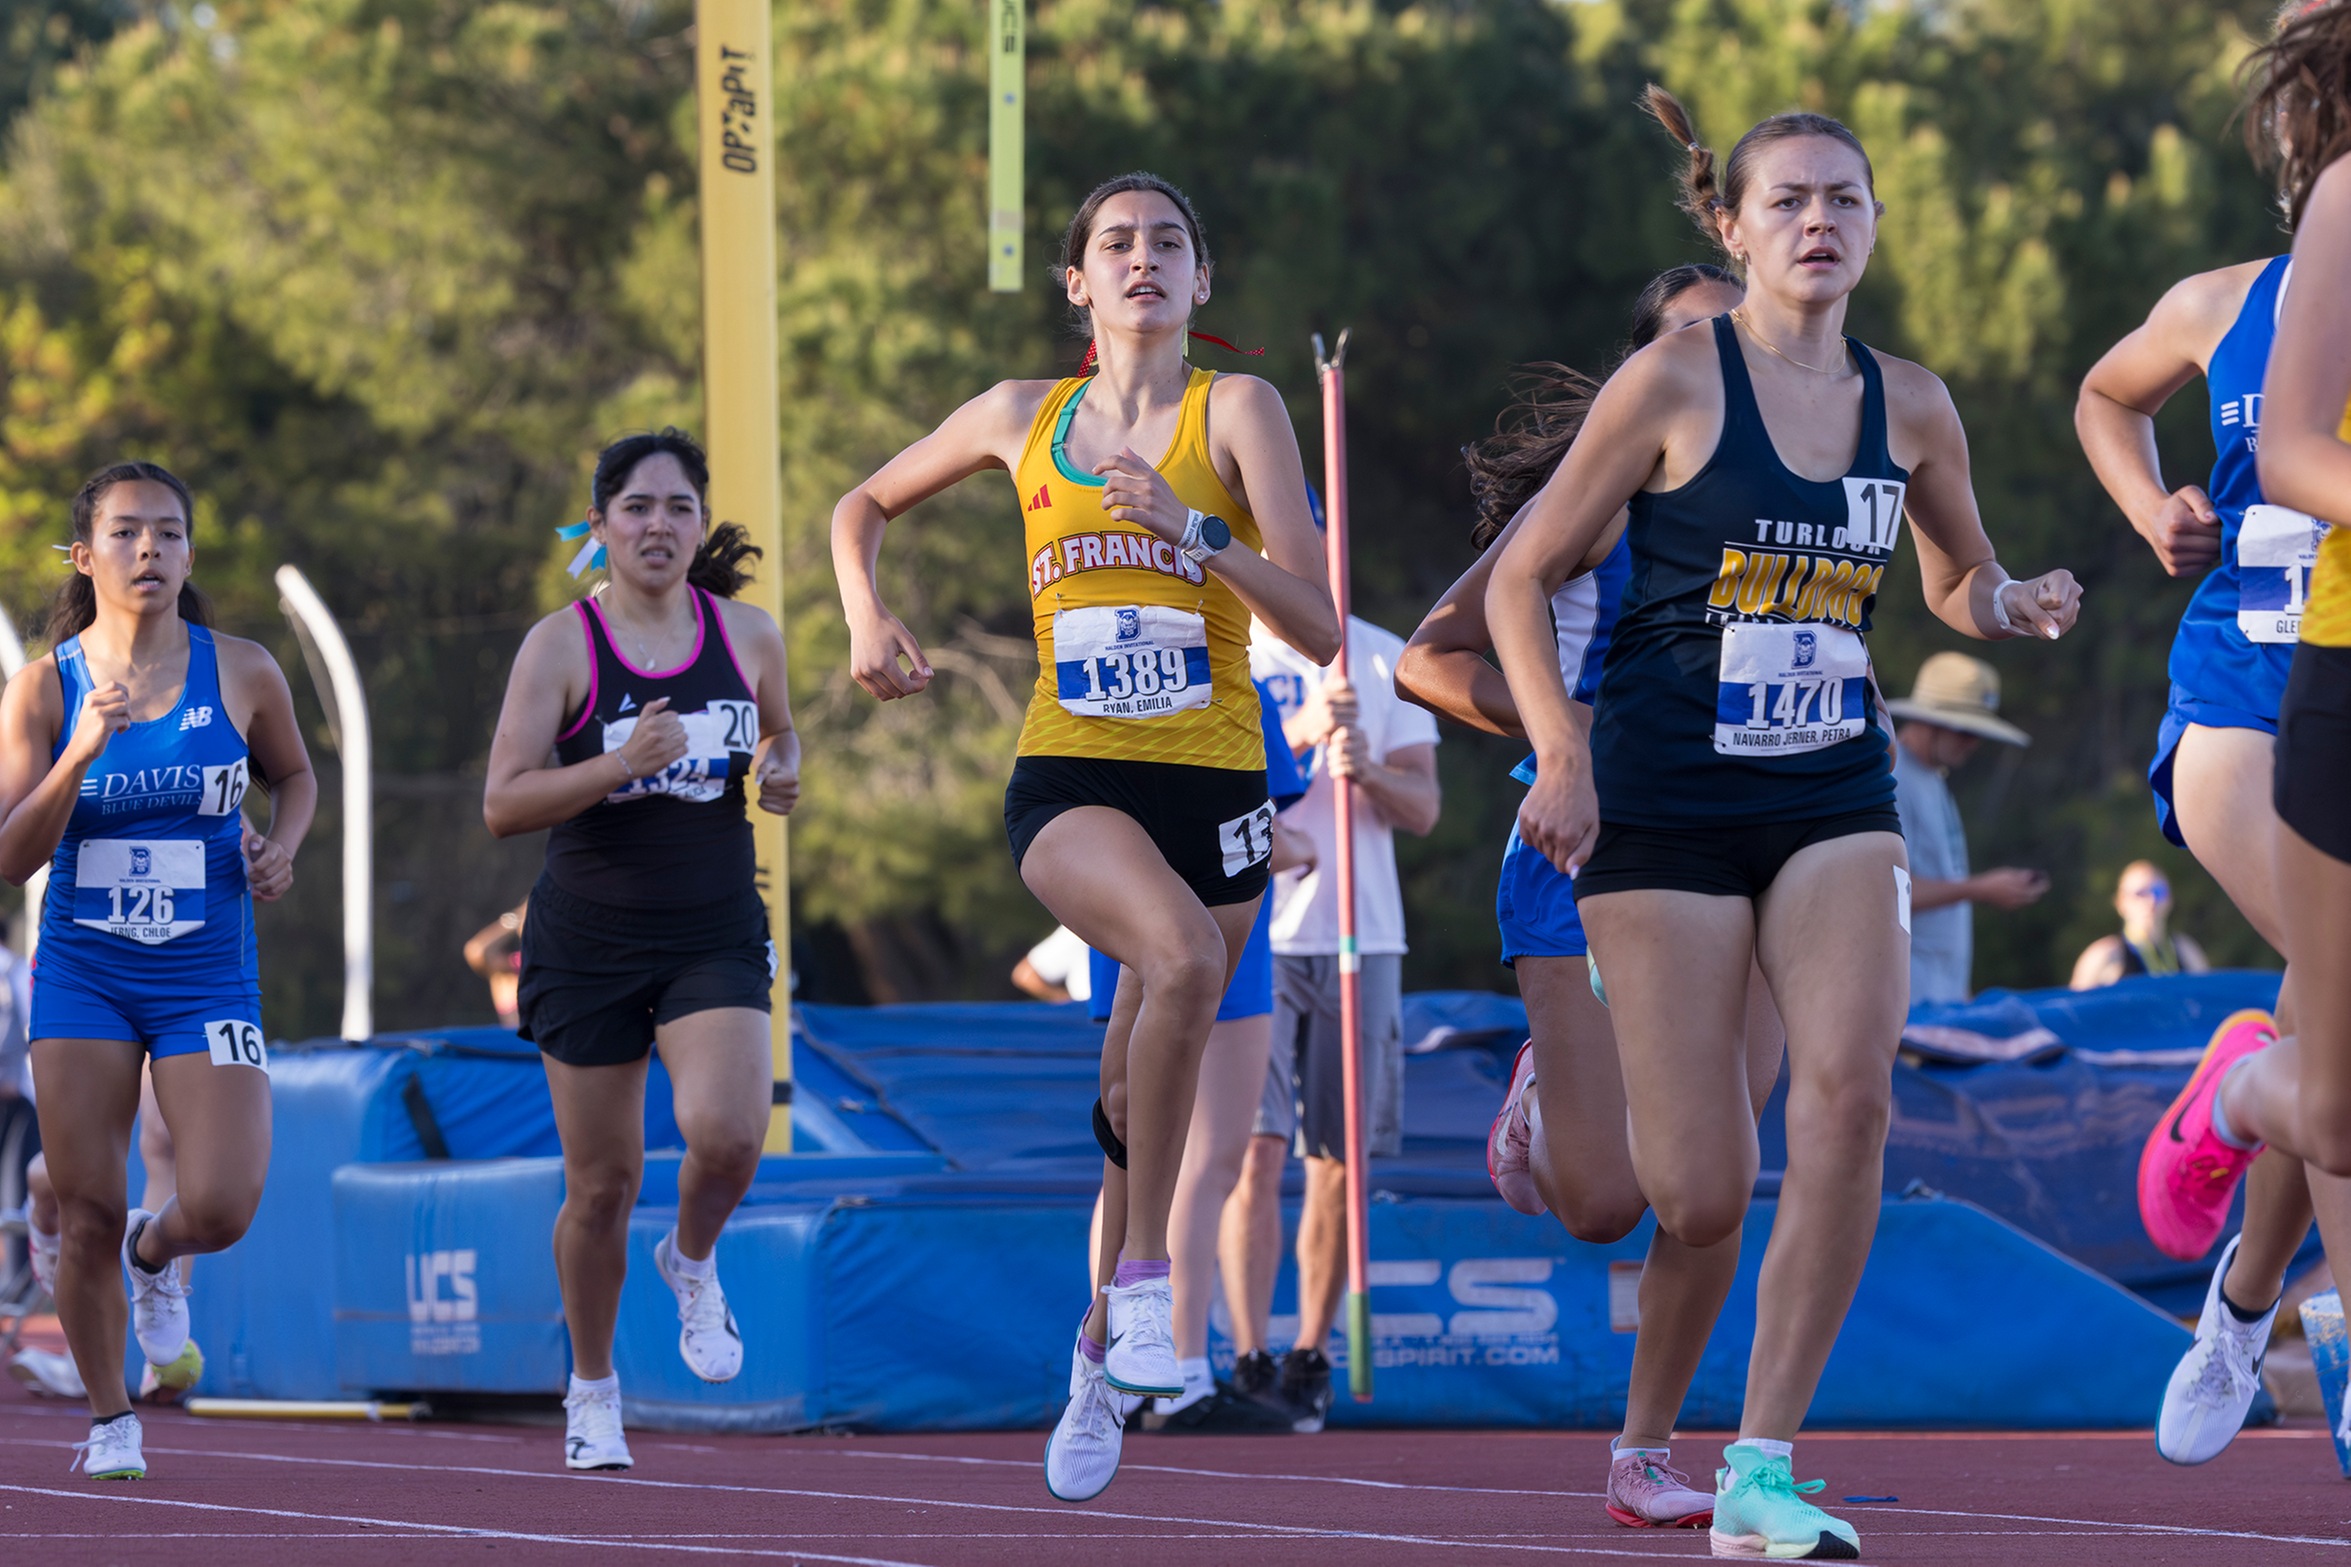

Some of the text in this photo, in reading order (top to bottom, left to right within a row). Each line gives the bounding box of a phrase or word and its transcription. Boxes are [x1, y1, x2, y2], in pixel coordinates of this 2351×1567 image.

[1859, 483, 1901, 546] 17
[1031, 542, 1063, 599] ST.
[1059, 530, 1206, 586] FRANCIS
[1082, 645, 1188, 702] 1389
[1103, 696, 1173, 714] RYAN, EMILIA
[1745, 676, 1844, 730] 1470
[720, 703, 755, 750] 20
[1733, 728, 1851, 747] NAVARRO JERNER, PETRA
[100, 763, 201, 799] DAVIS
[214, 763, 244, 814] 16
[101, 800, 143, 816] BLUE
[107, 884, 175, 925] 126
[142, 926, 171, 938] CHLOE
[218, 1022, 262, 1066] 16
